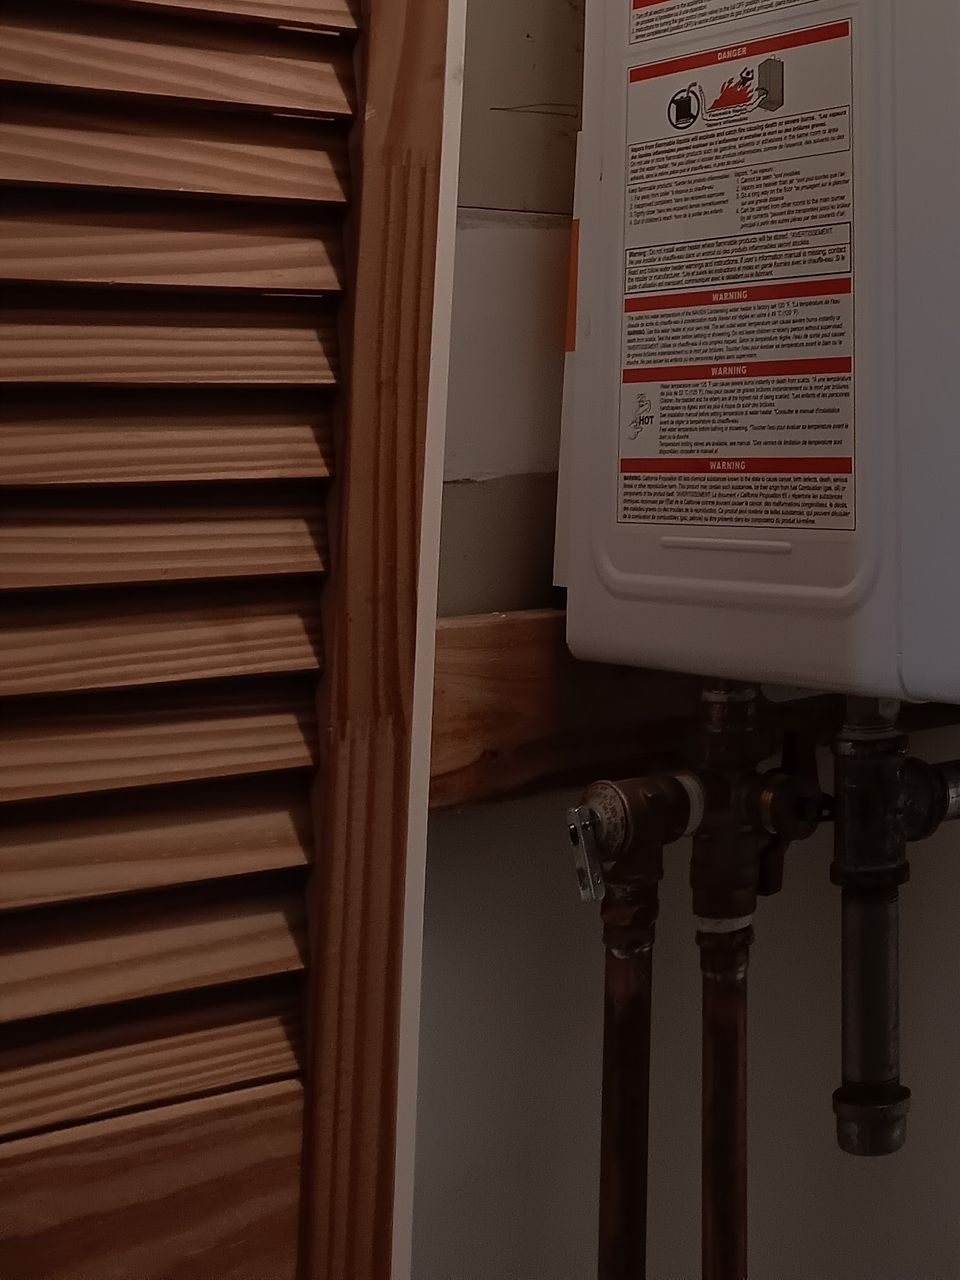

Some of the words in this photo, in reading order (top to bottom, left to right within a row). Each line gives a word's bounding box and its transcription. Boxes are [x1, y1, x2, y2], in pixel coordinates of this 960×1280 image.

[717, 46, 746, 59] DANGER
[712, 290, 748, 302] WARNING
[712, 366, 746, 376] WARNING
[638, 416, 654, 426] HOT
[710, 461, 746, 470] WARNING
